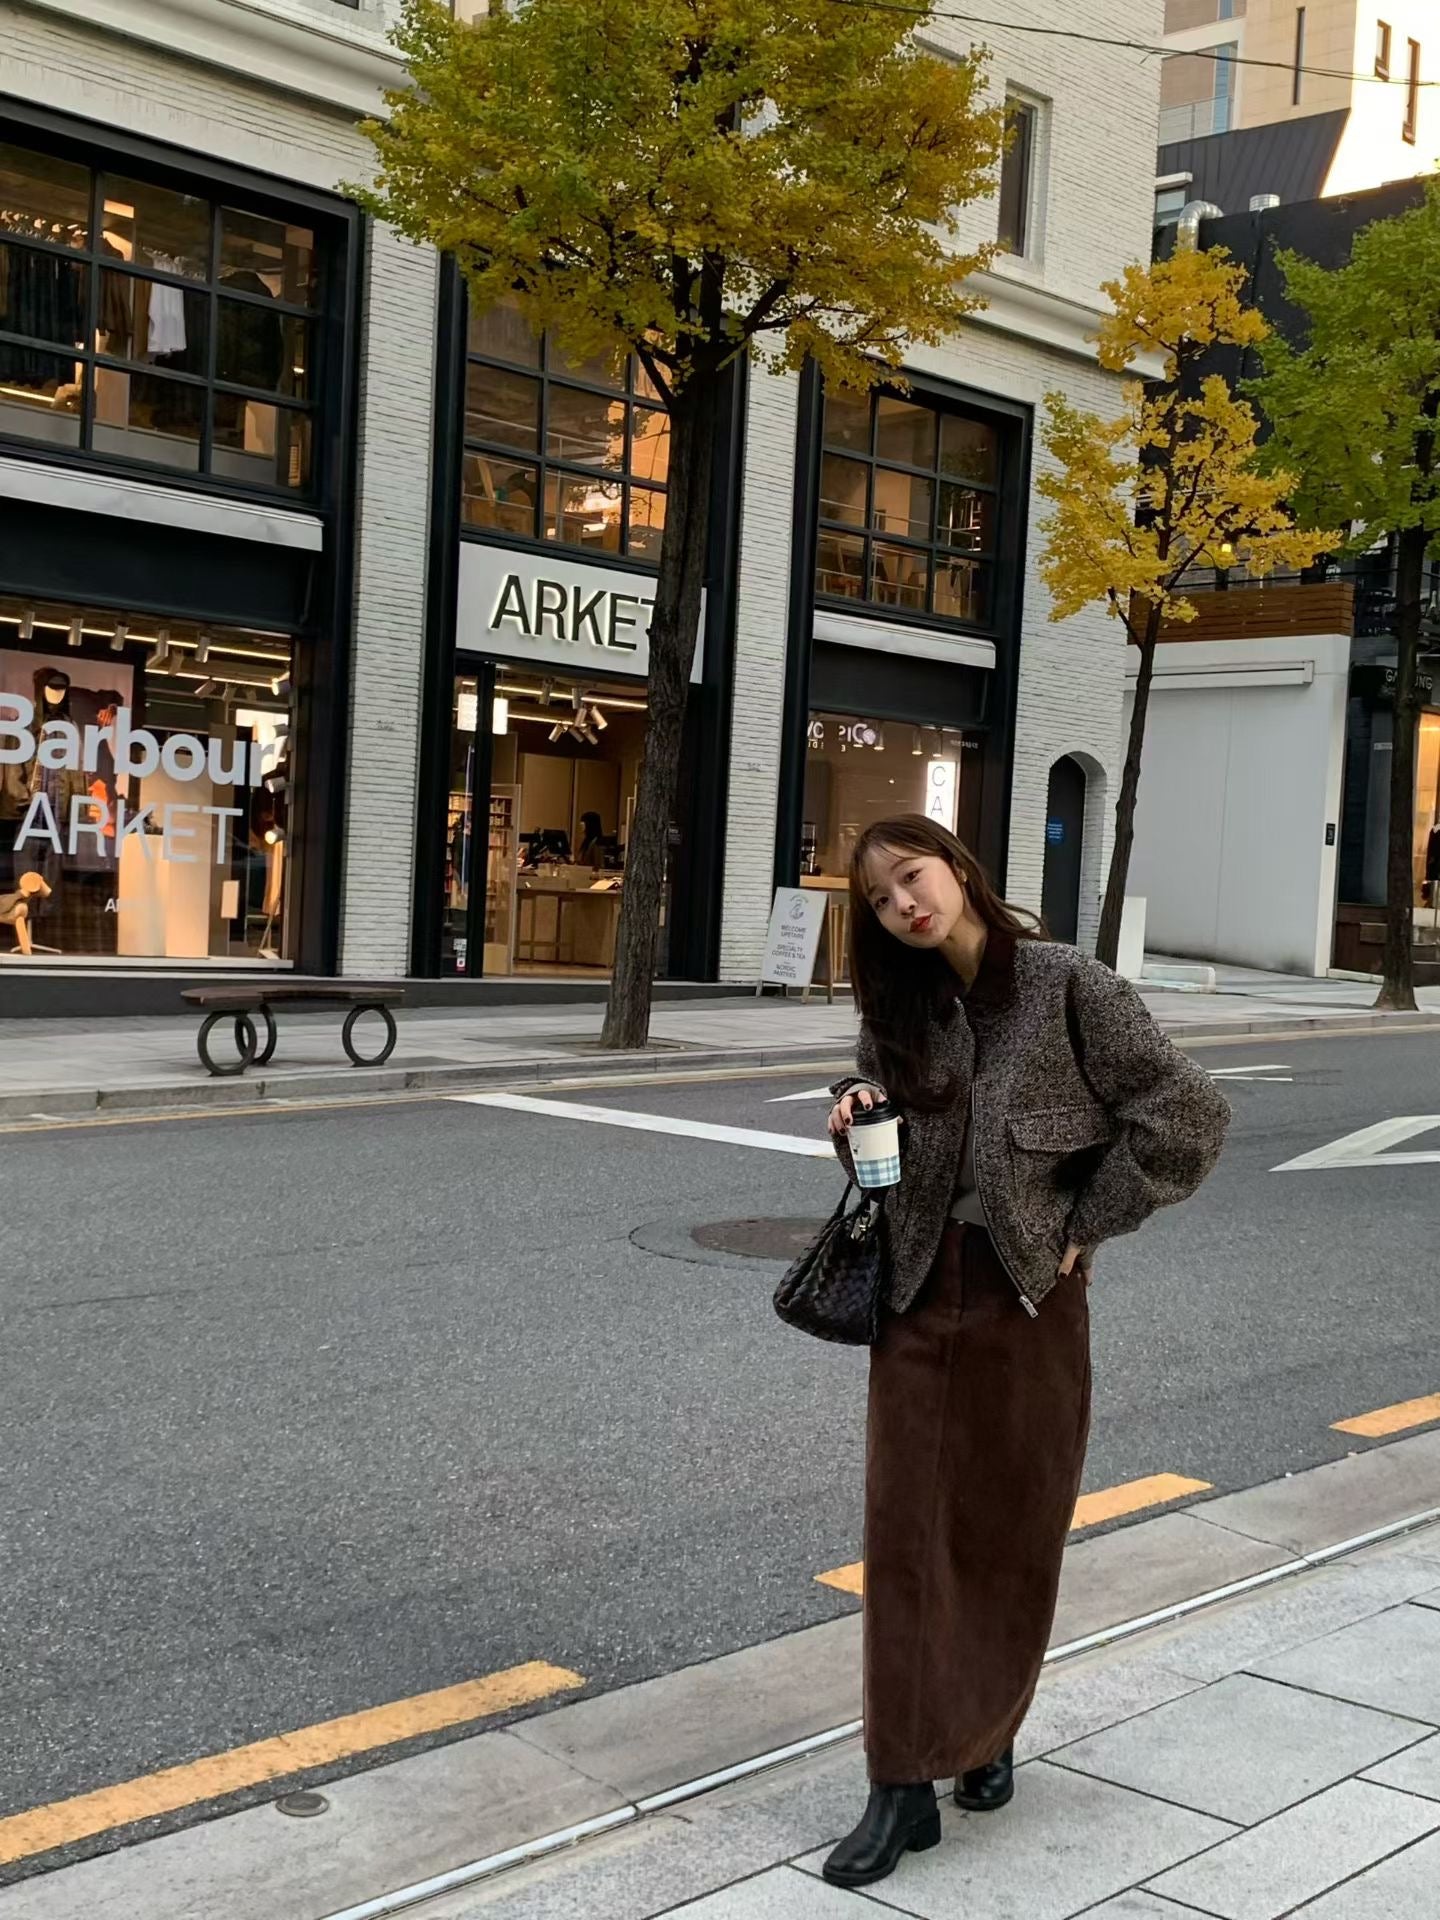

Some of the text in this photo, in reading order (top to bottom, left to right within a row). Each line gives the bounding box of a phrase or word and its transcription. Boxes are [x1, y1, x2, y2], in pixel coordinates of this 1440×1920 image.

[489, 573, 656, 651] ARKE
[0, 693, 276, 788] Barbour
[13, 791, 243, 865] ARKET
